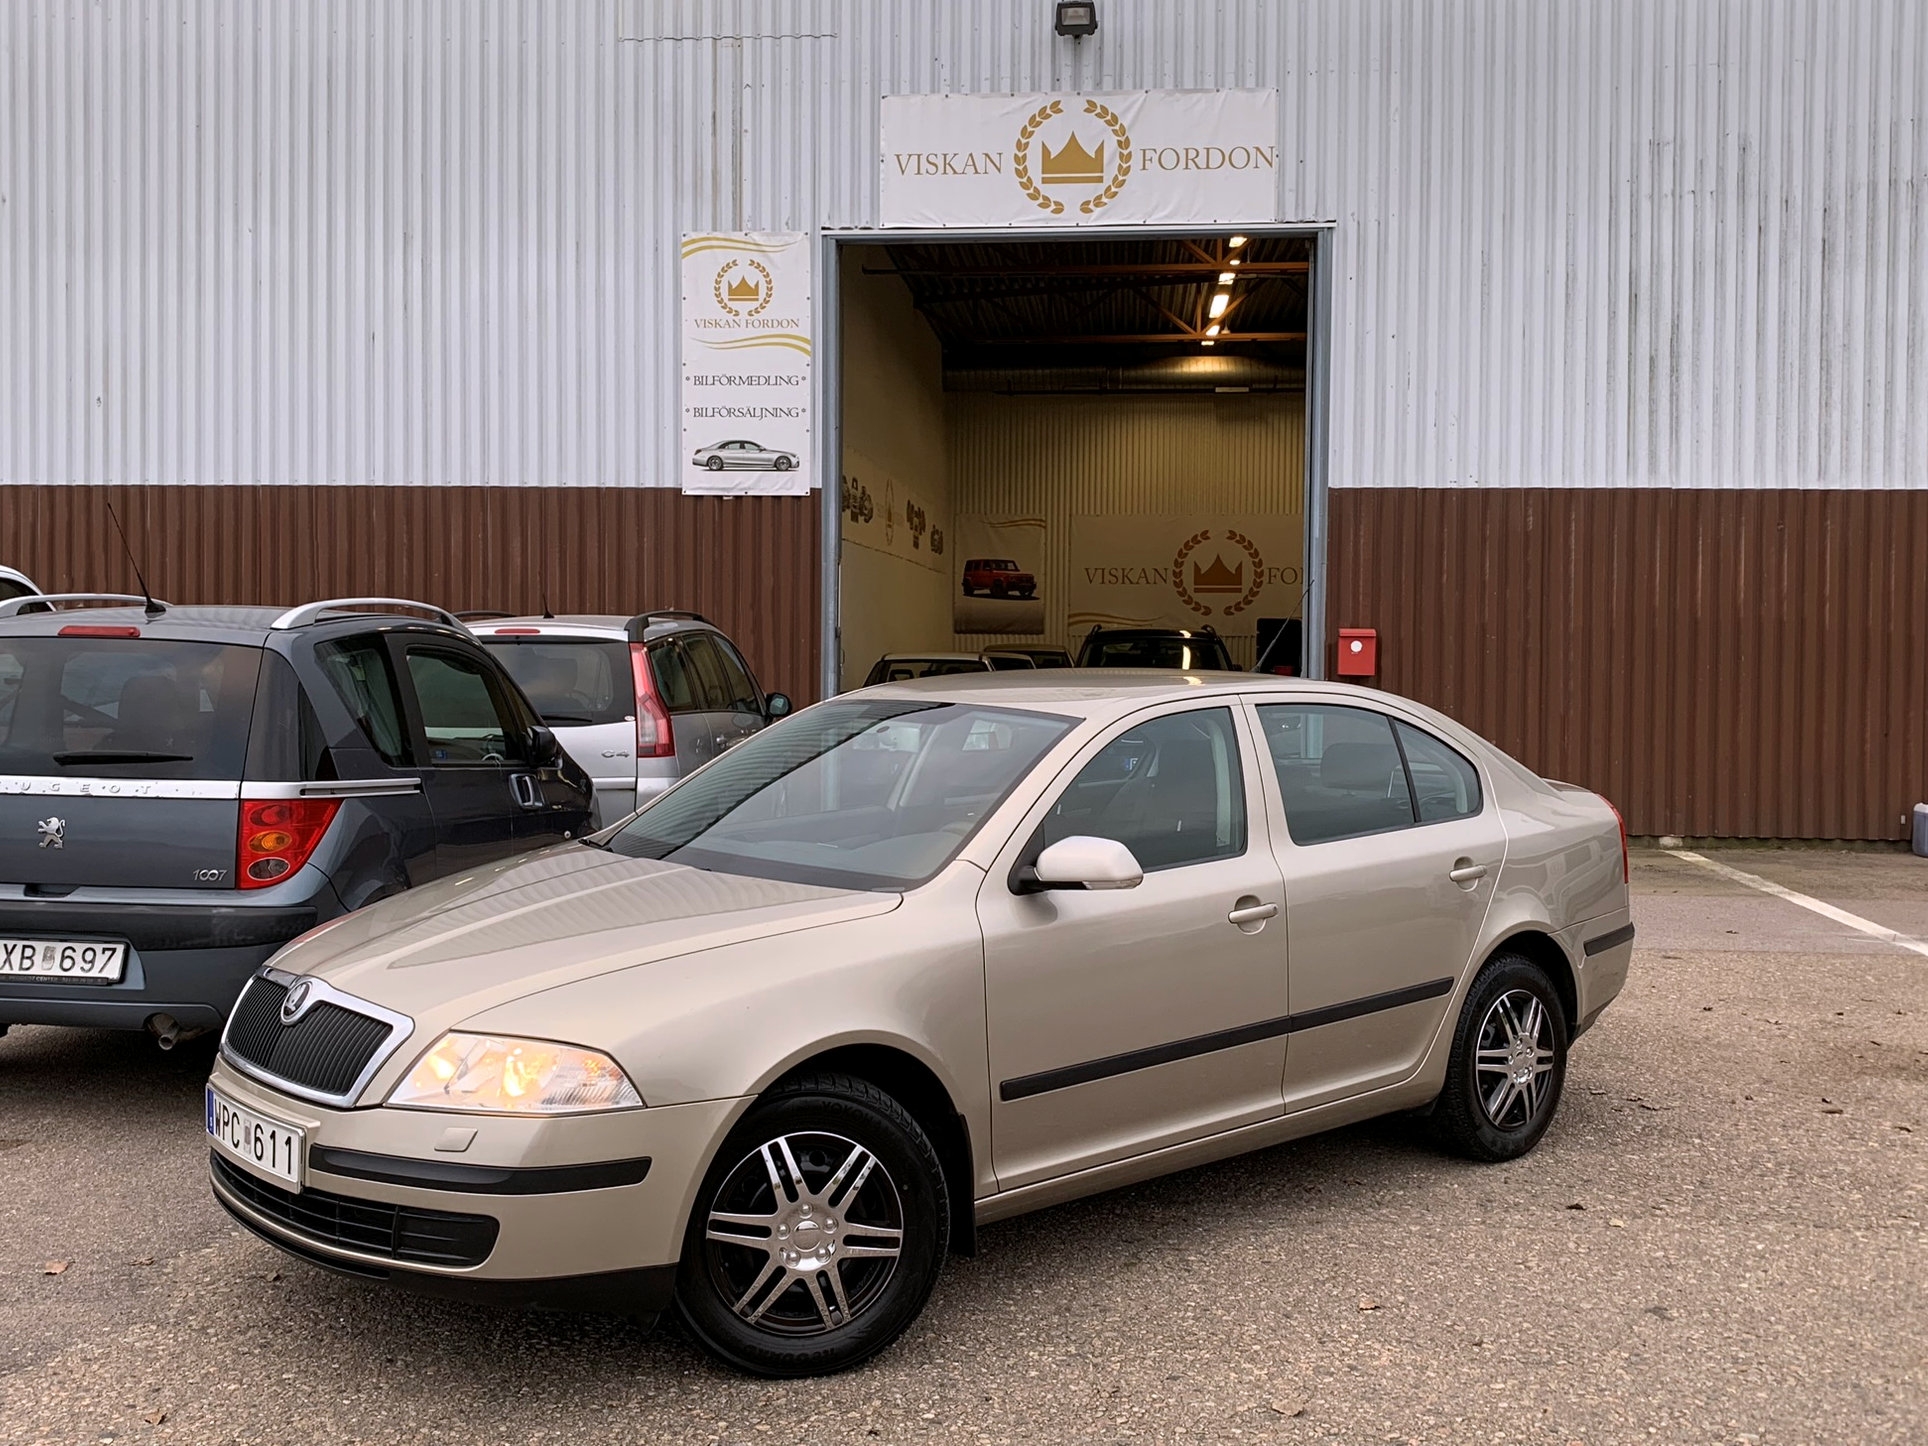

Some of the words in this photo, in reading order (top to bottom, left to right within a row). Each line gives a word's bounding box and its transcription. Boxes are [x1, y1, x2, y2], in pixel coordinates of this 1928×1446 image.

[894, 152, 1003, 177] VISKAN
[1139, 145, 1276, 172] FORDON
[694, 318, 742, 329] VISKAN
[745, 318, 800, 329] FORDON
[693, 373, 799, 387] BILFÖRMEDLING
[693, 405, 799, 421] BILFÖRSÄLJNING
[1085, 567, 1169, 585] VISKAN
[1265, 567, 1304, 585] FO
[193, 869, 227, 881] 1007
[0, 943, 36, 972] XB
[59, 946, 117, 974] 697
[214, 1098, 240, 1149] WPC
[254, 1123, 292, 1175] 611
